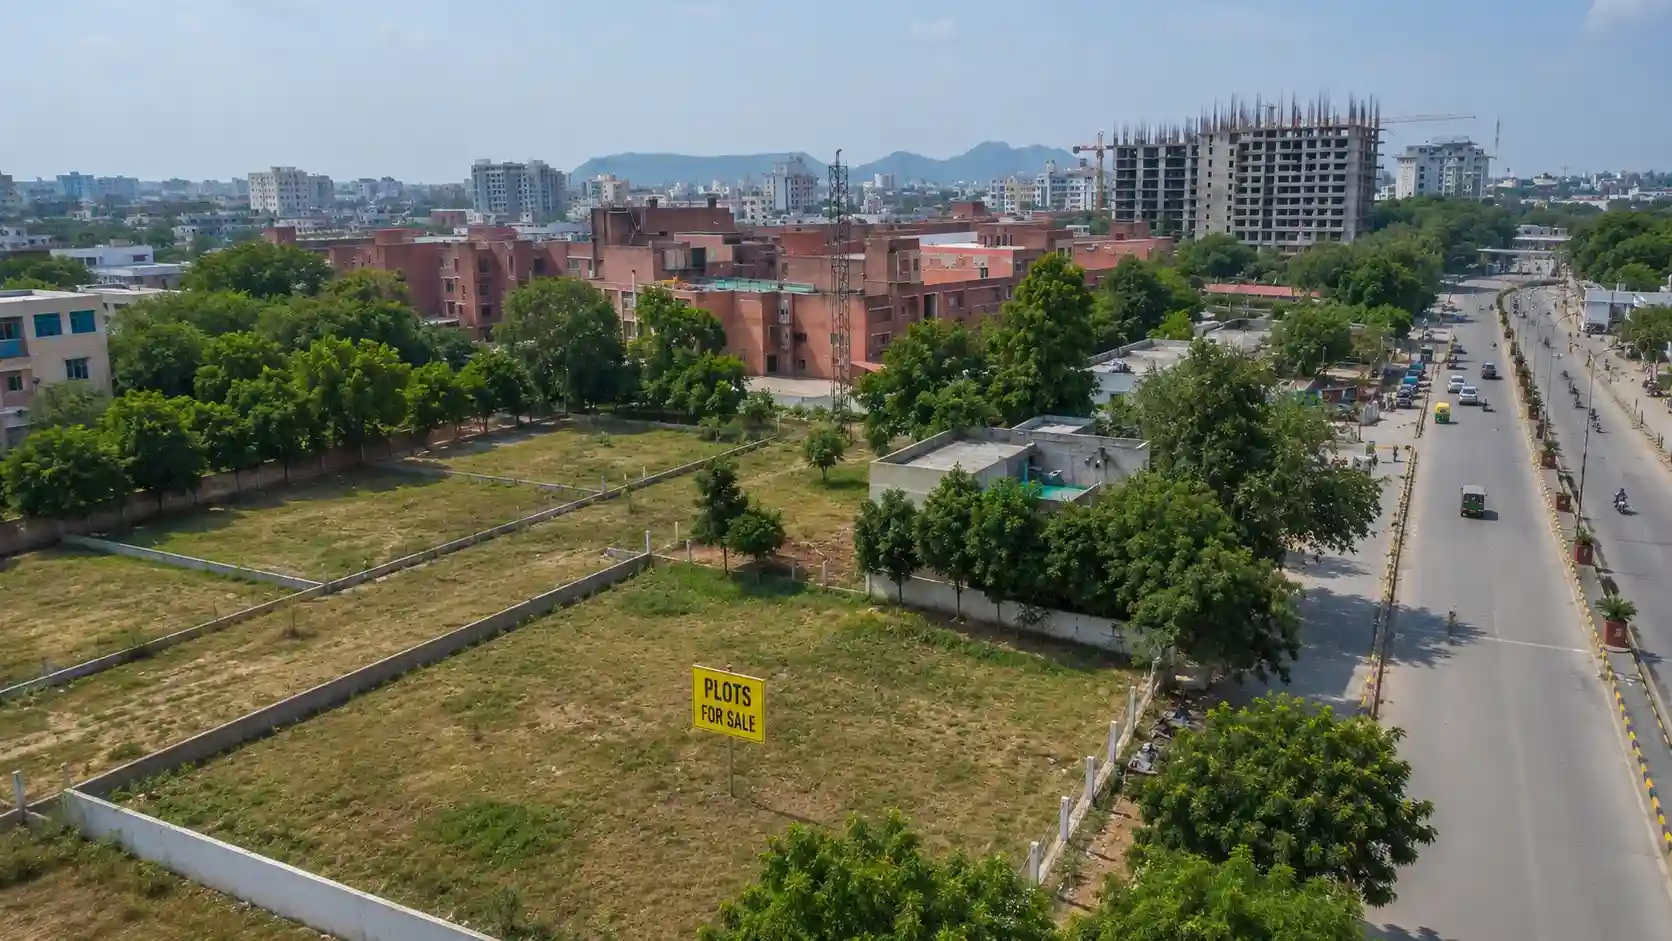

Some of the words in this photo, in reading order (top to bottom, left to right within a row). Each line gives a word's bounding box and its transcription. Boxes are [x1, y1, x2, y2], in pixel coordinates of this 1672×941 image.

[704, 677, 752, 707] PLOTS
[701, 704, 723, 725] FOR
[727, 710, 756, 732] SALE
